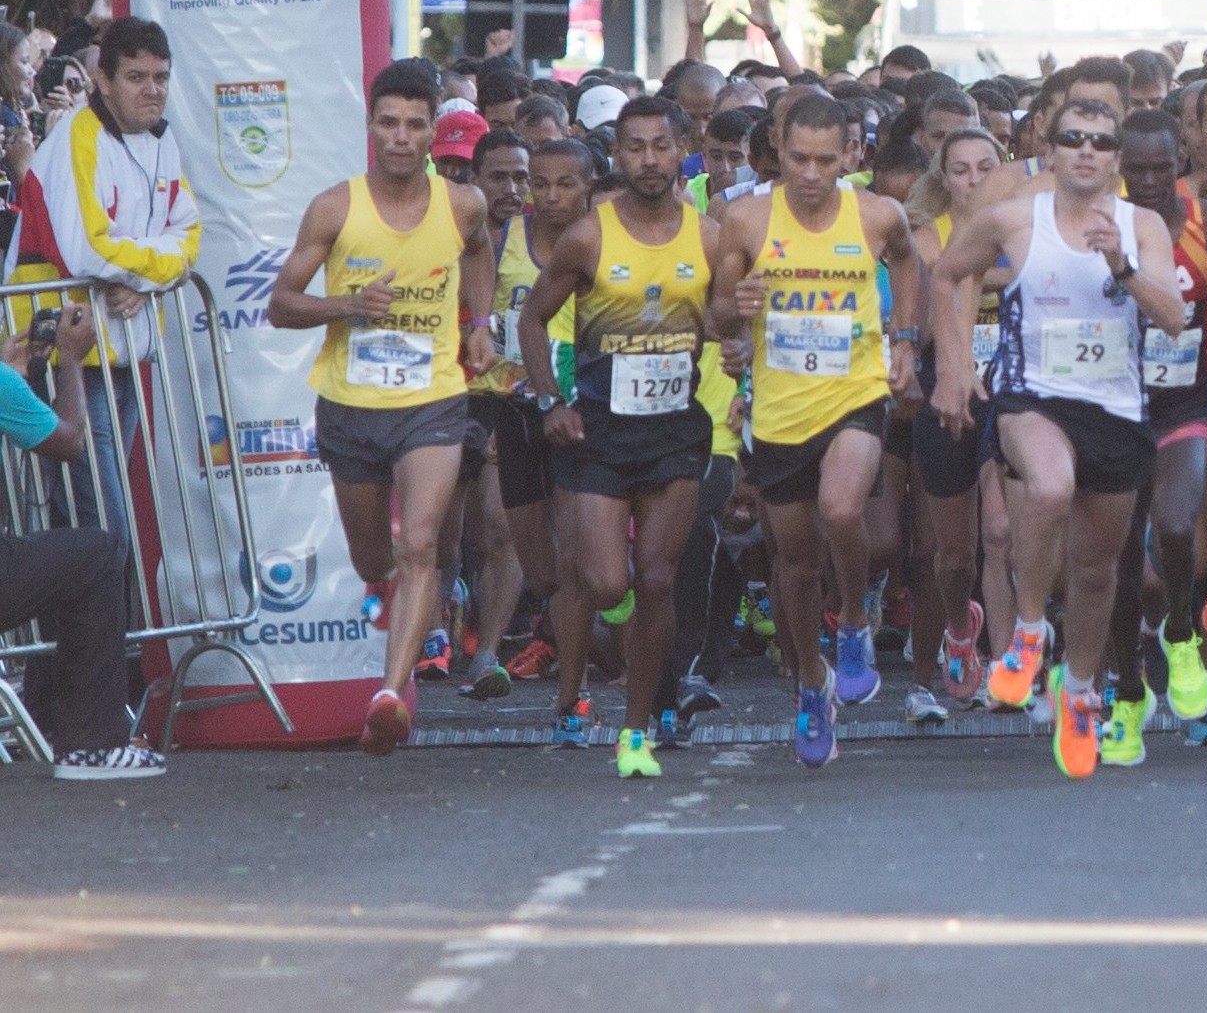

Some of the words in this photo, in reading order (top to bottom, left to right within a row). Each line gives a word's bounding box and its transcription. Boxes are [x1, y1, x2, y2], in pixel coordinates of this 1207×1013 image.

[770, 290, 857, 312] CAIXA
[784, 336, 841, 348] MARCELO
[804, 352, 818, 372] 8
[1075, 343, 1105, 362] 29
[381, 366, 406, 386] 15
[1153, 365, 1168, 384] 2
[631, 377, 682, 398] 1270
[285, 464, 302, 475] DA
